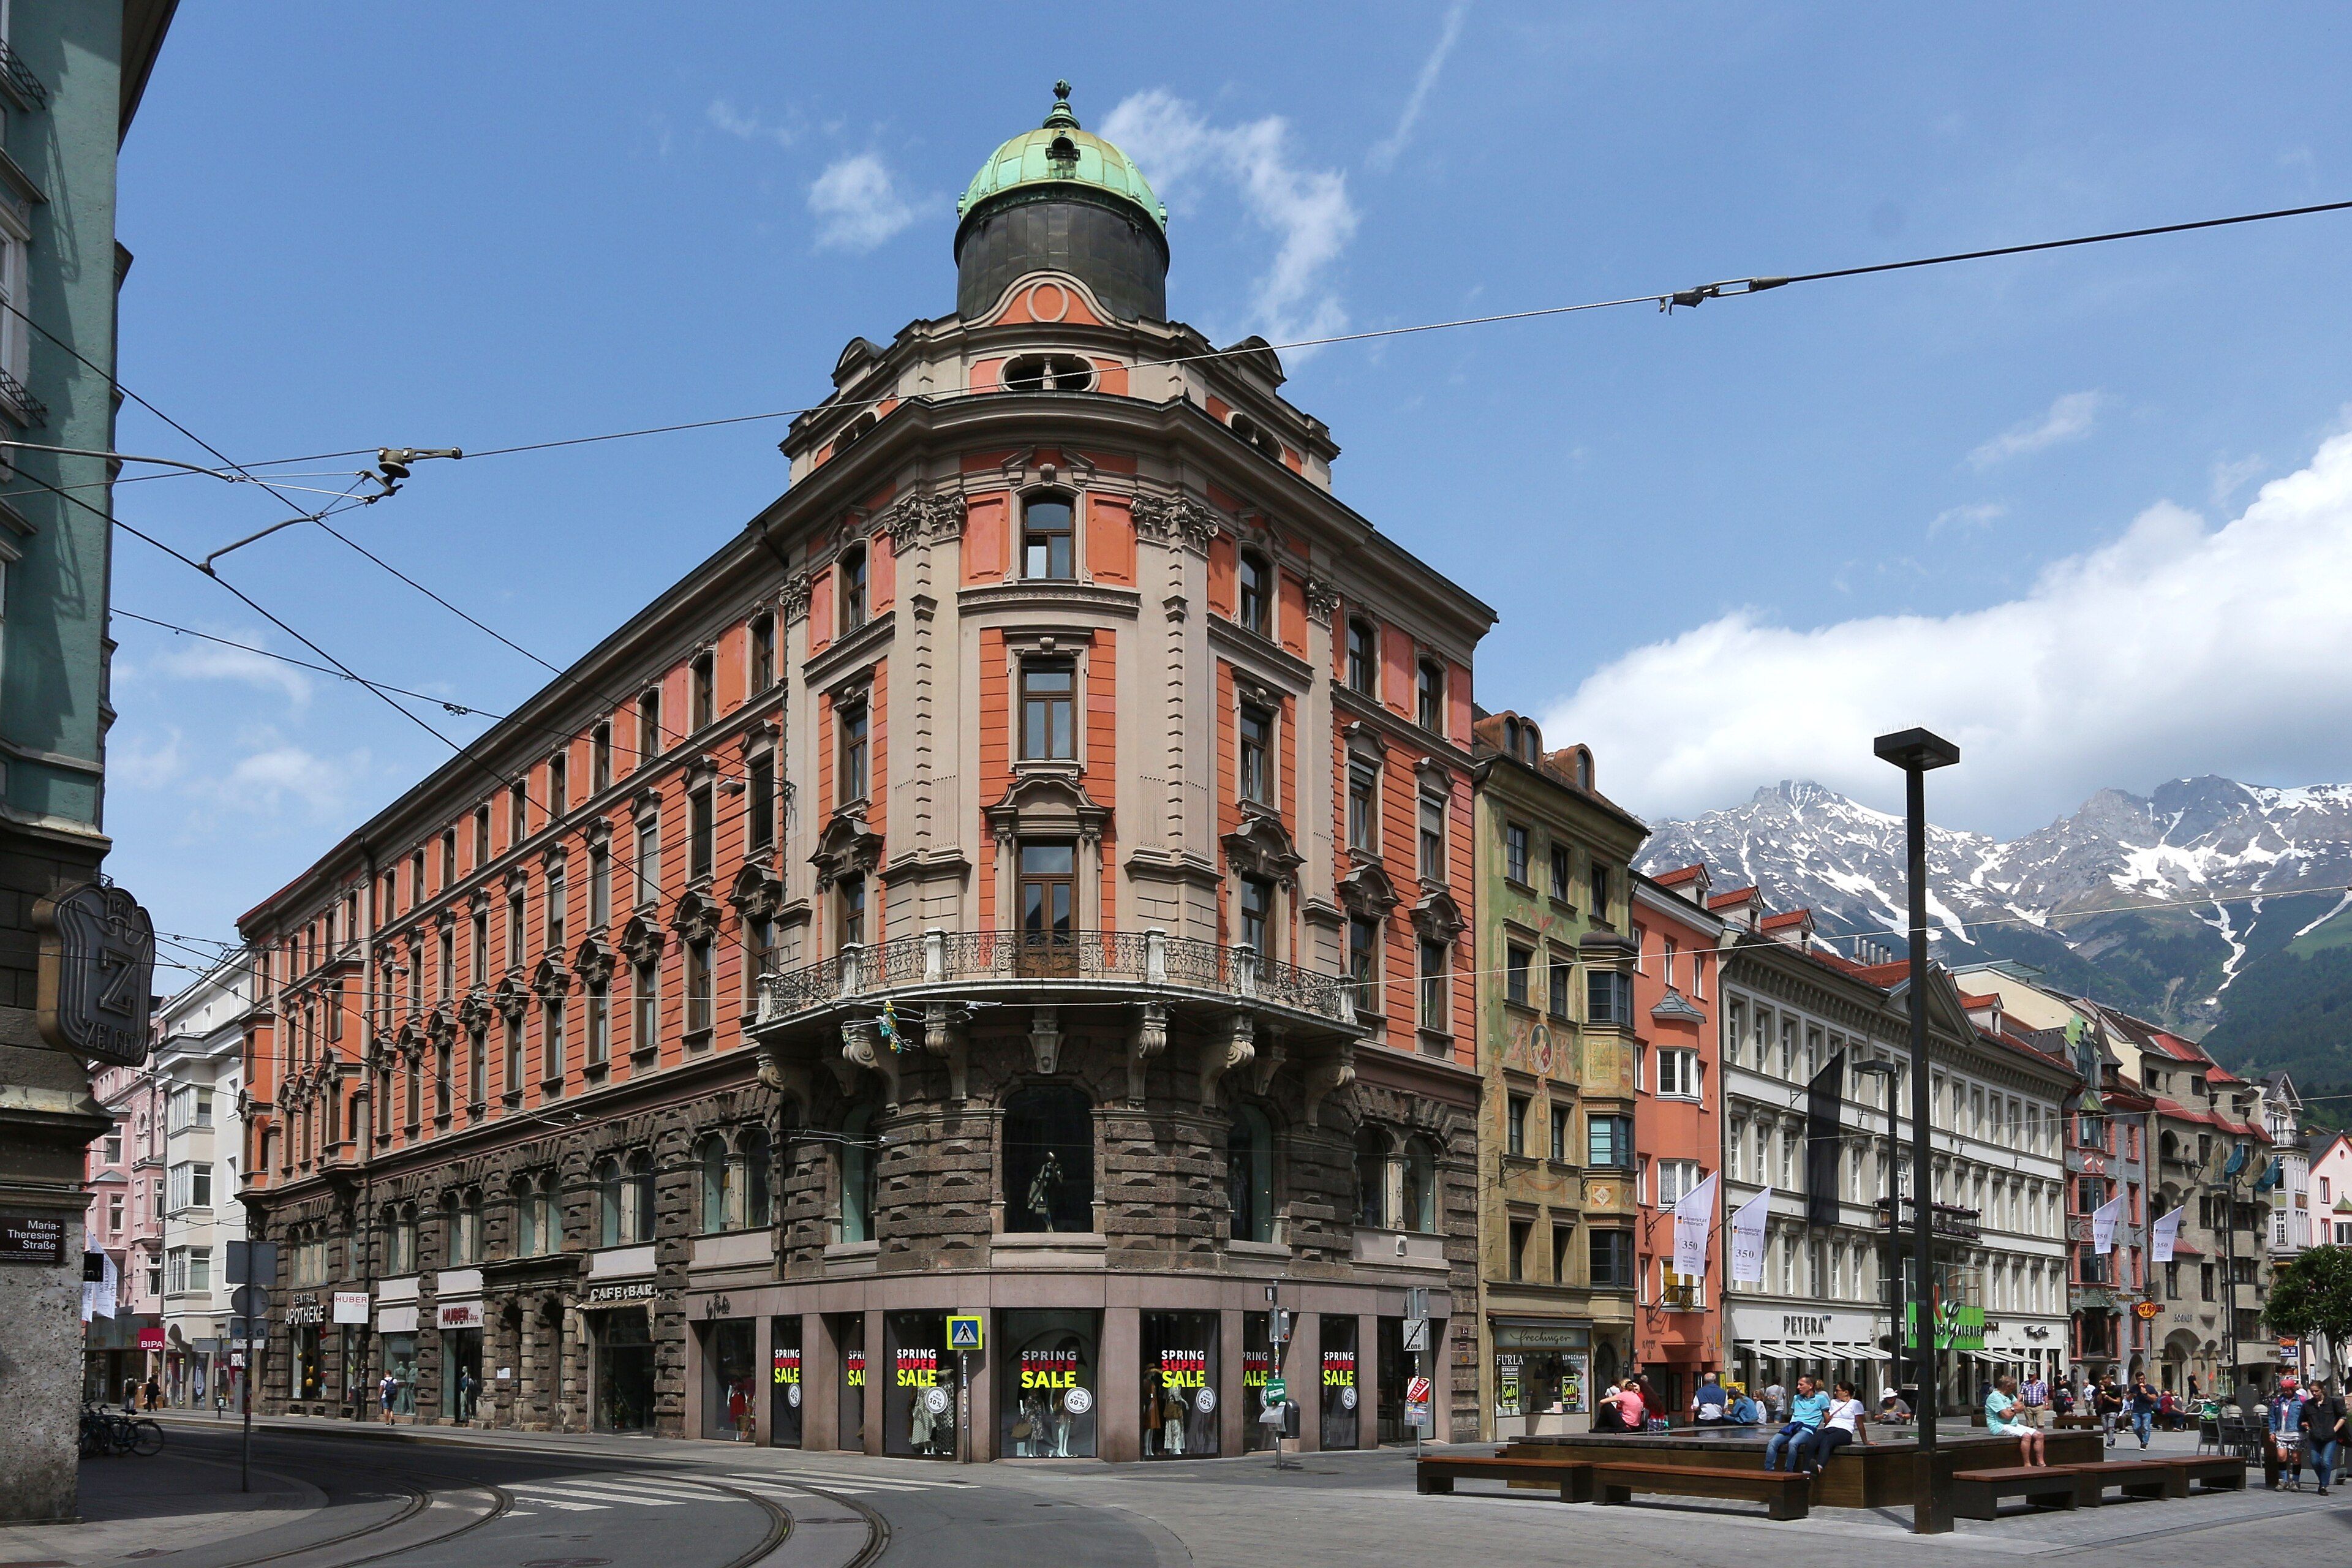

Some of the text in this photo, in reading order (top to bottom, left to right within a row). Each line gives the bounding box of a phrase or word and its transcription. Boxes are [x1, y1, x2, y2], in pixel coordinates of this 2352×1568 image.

[100, 946, 135, 1018] Z
[28, 1220, 60, 1230] Maria-
[7, 1229, 60, 1240] Theresien-
[23, 1240, 56, 1250] Straße
[1682, 1240, 1698, 1251] 350
[1736, 1249, 1754, 1259] 350
[628, 1284, 652, 1298] BAR
[293, 1292, 317, 1304] ZENTRAL
[285, 1305, 324, 1325] APOTHEKE
[1784, 1316, 1825, 1335] PETERA
[775, 1349, 800, 1358] SPRING
[897, 1349, 937, 1359] SPRING
[1022, 1351, 1077, 1360] SPRING
[1161, 1350, 1205, 1360] SPRING
[1324, 1352, 1354, 1360] SPRING
[774, 1359, 799, 1367] SUPER
[897, 1359, 937, 1370] SUPER
[1324, 1360, 1354, 1370] SUPER
[1496, 1354, 1524, 1365] FURLA
[1021, 1360, 1077, 1371] SUPER
[1161, 1360, 1205, 1371] SUPER
[774, 1368, 799, 1383] SALE
[897, 1369, 937, 1387] SALE
[1021, 1371, 1077, 1389] SALE
[1162, 1370, 1205, 1388] SALE
[1324, 1370, 1354, 1385] SALE
[1503, 1385, 1517, 1398] Sale
[1563, 1384, 1575, 1395] Sale
